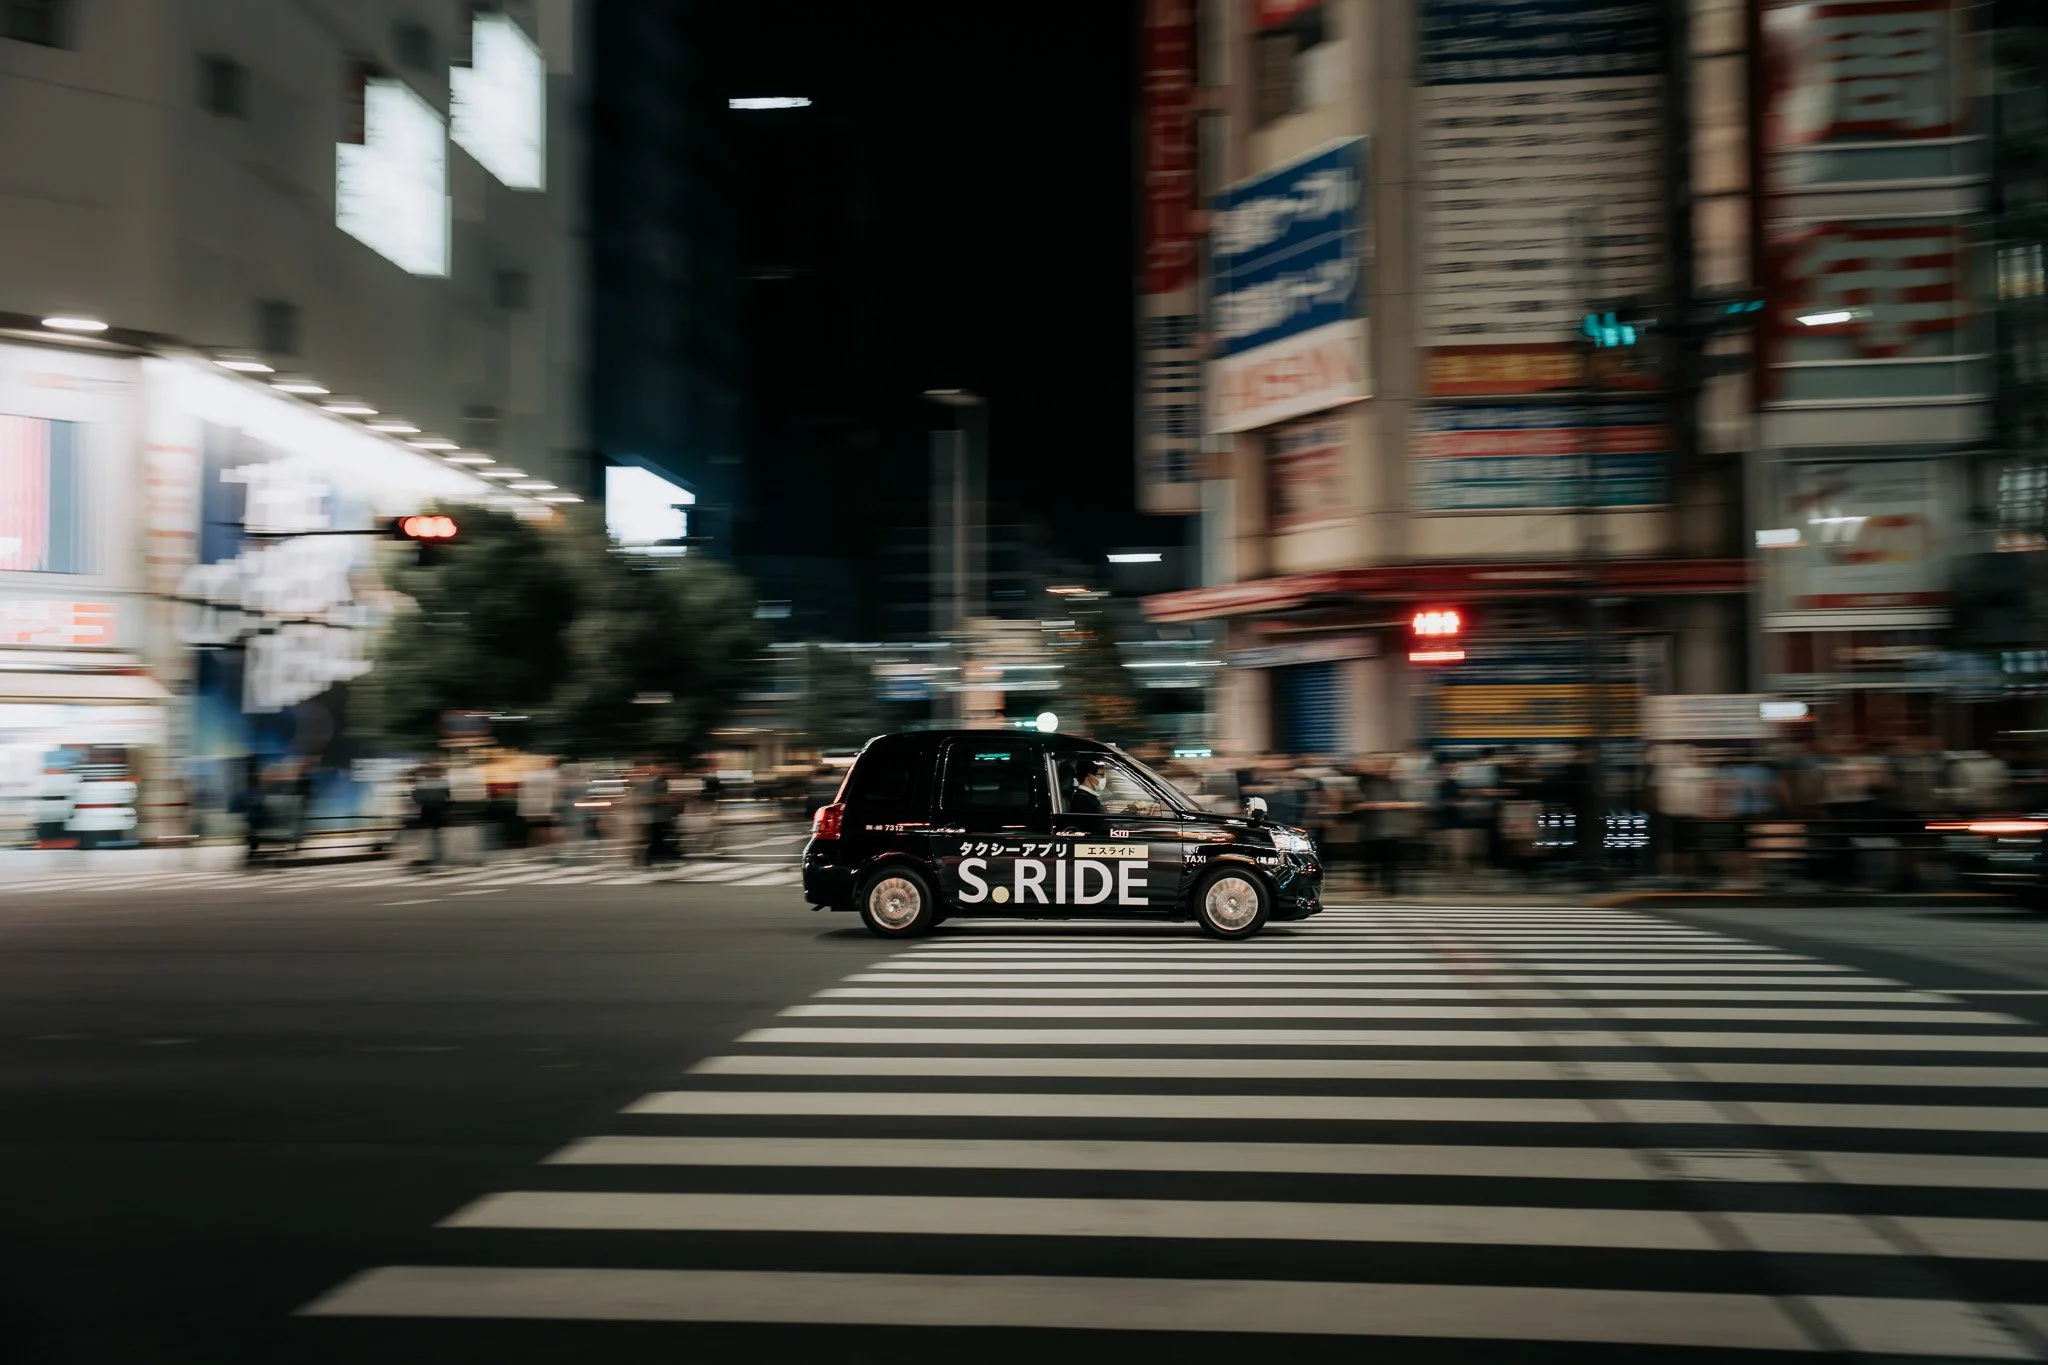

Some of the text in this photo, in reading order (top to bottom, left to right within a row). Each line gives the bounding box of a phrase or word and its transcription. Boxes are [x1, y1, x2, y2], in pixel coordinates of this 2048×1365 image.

[959, 842, 1067, 857] タクシーアプリ
[1087, 847, 1136, 856] エスライド
[1184, 854, 1207, 864] TAXI
[958, 857, 1149, 906] S.RIDE
